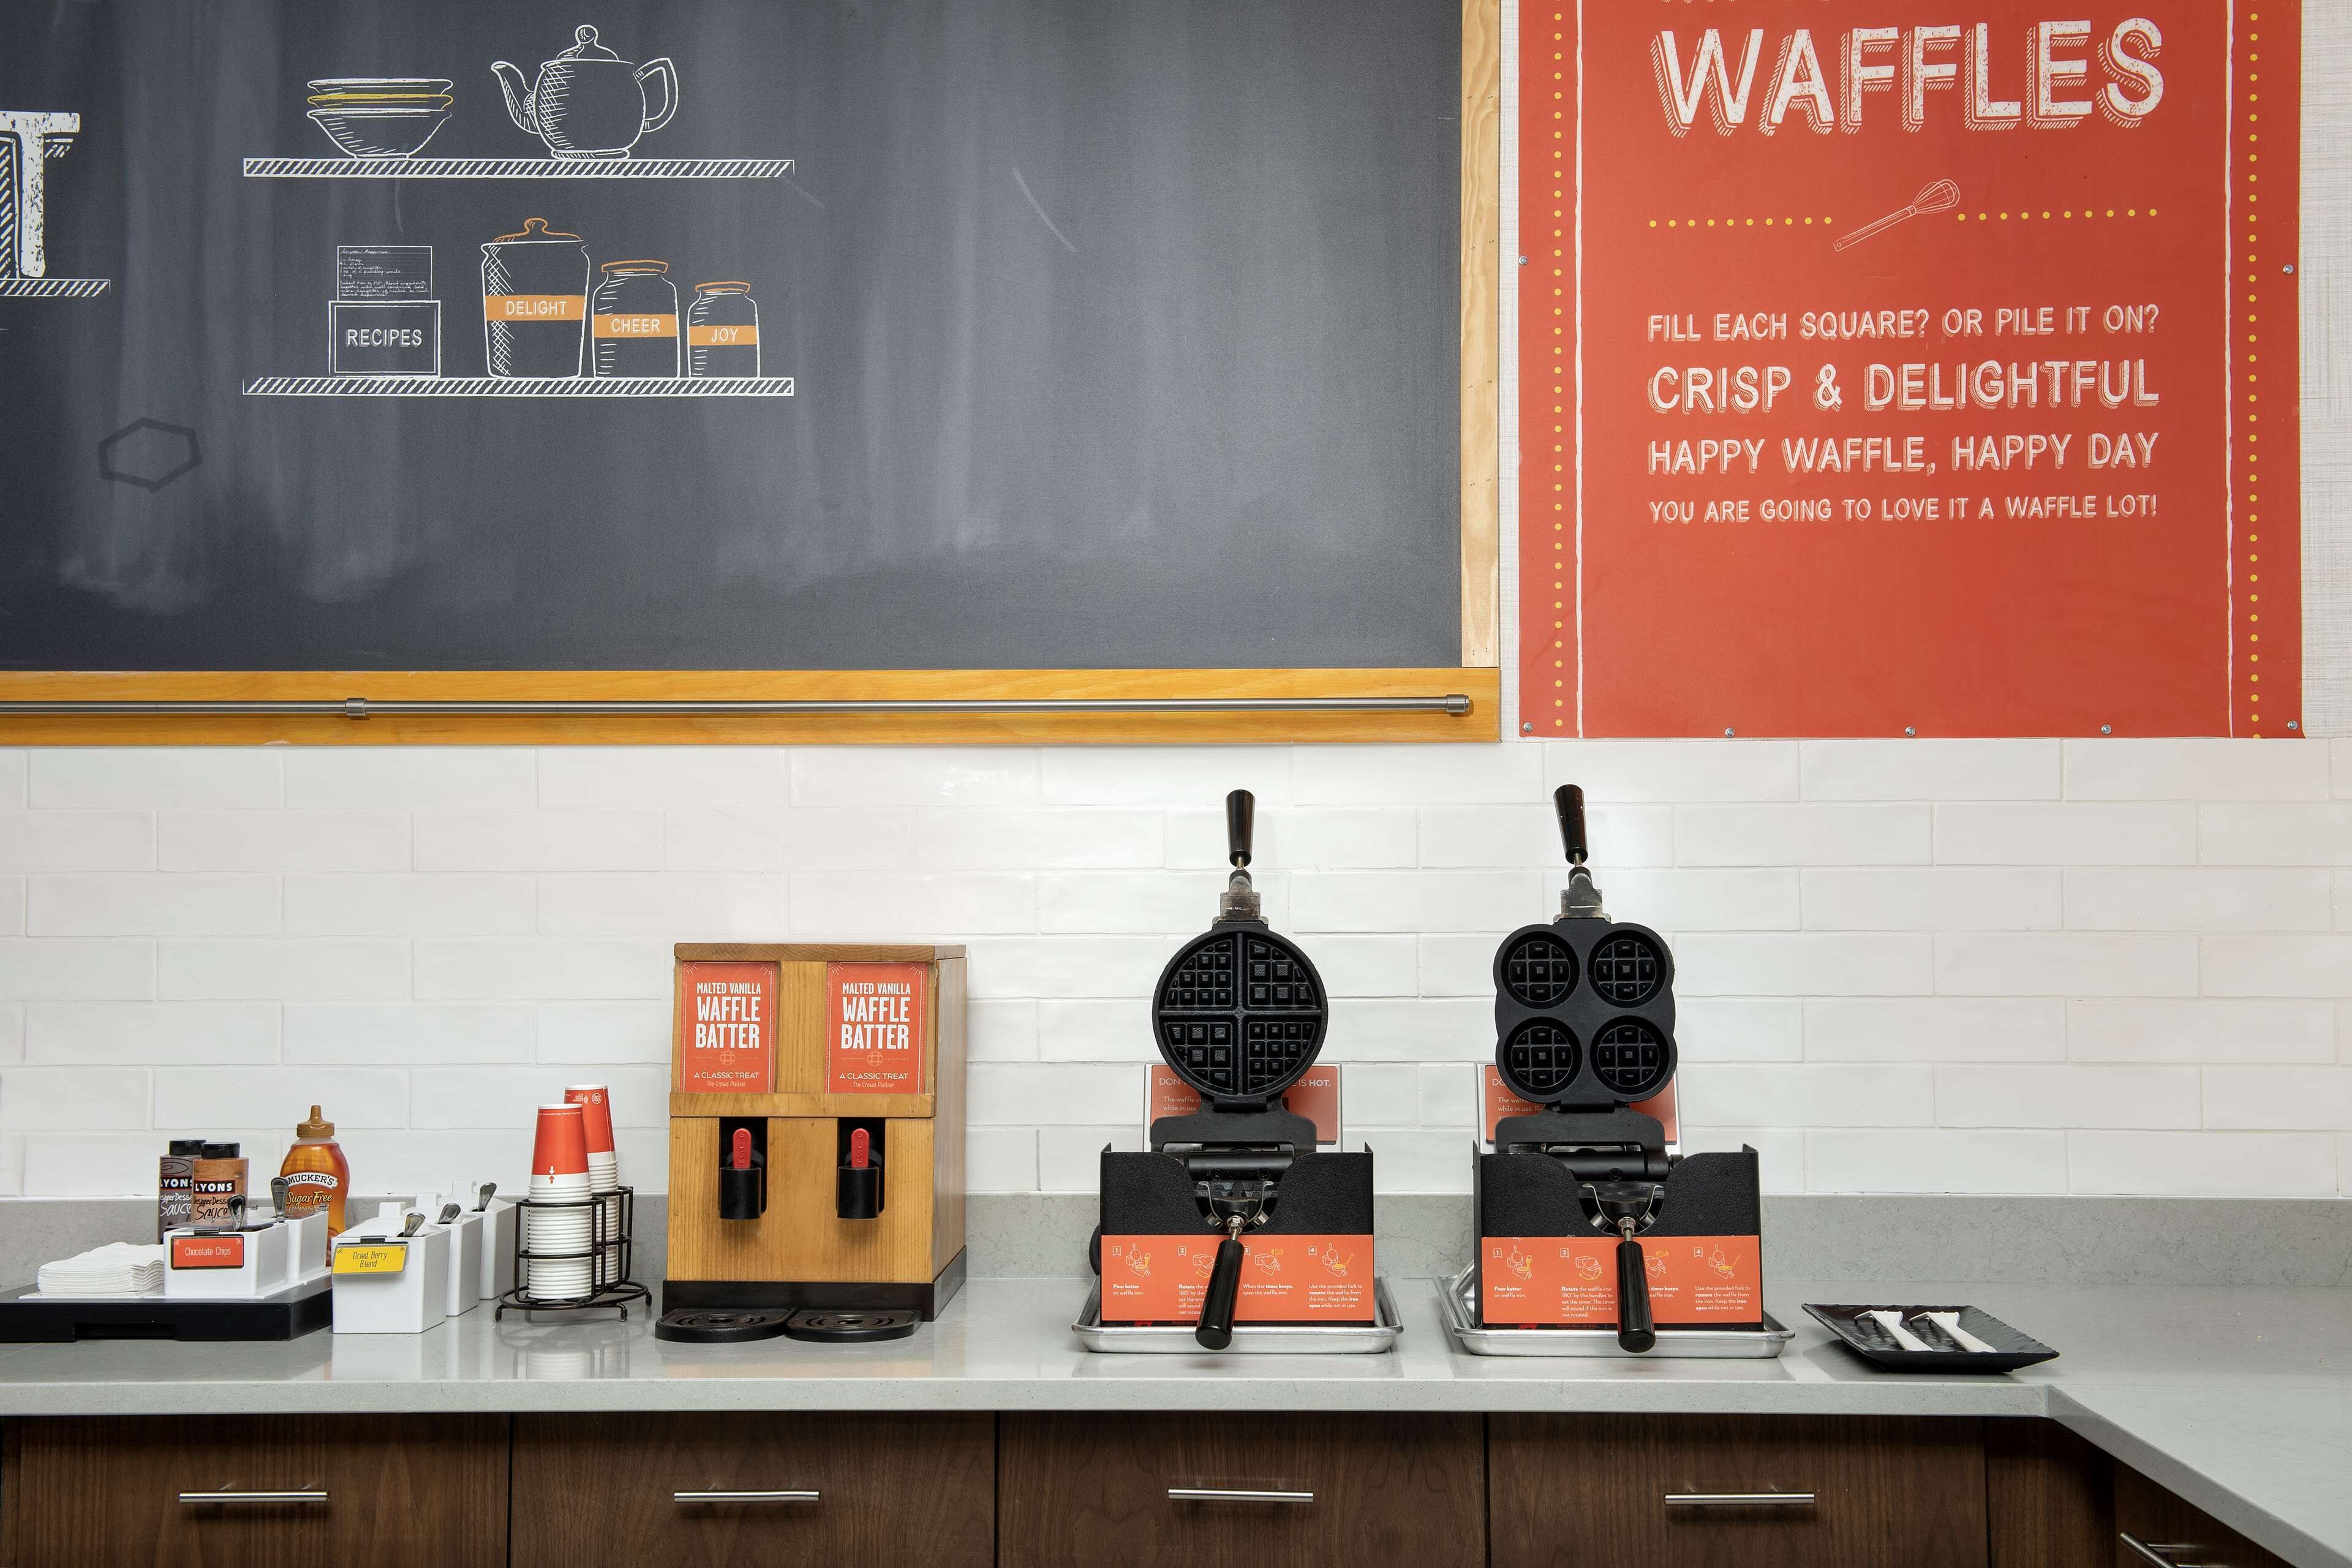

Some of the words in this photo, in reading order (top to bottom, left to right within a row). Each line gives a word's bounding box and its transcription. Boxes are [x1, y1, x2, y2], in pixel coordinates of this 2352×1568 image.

[1651, 18, 2163, 138] WAFFLES
[506, 301, 567, 315] DELIGHT
[611, 318, 660, 334] CHEER
[1648, 314, 1701, 342] FILL
[1714, 312, 1786, 341] EACH
[1800, 309, 1929, 340] SQUARE?
[1942, 309, 1983, 337] OR
[1996, 307, 2054, 334] PILE
[2067, 307, 2090, 334] IT
[2104, 304, 2158, 333] ON?
[346, 328, 422, 347] RECIPES
[710, 328, 739, 343] JOY
[1648, 366, 1791, 415] CRISP
[1813, 364, 1842, 412] &
[1864, 360, 2158, 411] DELIGHTFUL
[1648, 439, 1765, 475] HAPPY
[1781, 437, 1936, 476] WAFFLE,
[1953, 434, 2071, 470] HAPPY
[2089, 432, 2158, 468] DAY
[1649, 500, 1695, 524] YOU
[1704, 500, 1749, 522] ARE
[1760, 499, 1832, 522] GOING
[1842, 499, 1872, 521] TO
[1881, 497, 1940, 521] LOVE
[1948, 497, 1969, 519] IT
[1979, 497, 1994, 519] A
[2005, 496, 2097, 519] WAFFLE
[2107, 494, 2157, 518] LOT!
[696, 983, 726, 994] MALTED
[730, 982, 761, 994] VANILLA
[843, 983, 874, 994] MALTED
[878, 983, 911, 994] VANILLA
[696, 997, 761, 1021] WAFFLE
[843, 997, 910, 1022] WAFFLE
[696, 1023, 760, 1048] BATTER
[841, 1024, 909, 1049] BATTER
[195, 1183, 233, 1192] LYONS
[288, 1175, 334, 1185] MUCKER'S
[287, 1191, 312, 1208] Sugar
[312, 1191, 333, 1205] Free
[184, 1247, 213, 1256] Chocolate
[216, 1246, 232, 1257] Chips
[353, 1251, 369, 1259] Dried
[371, 1251, 388, 1261] Berry
[360, 1259, 378, 1268] Blend
